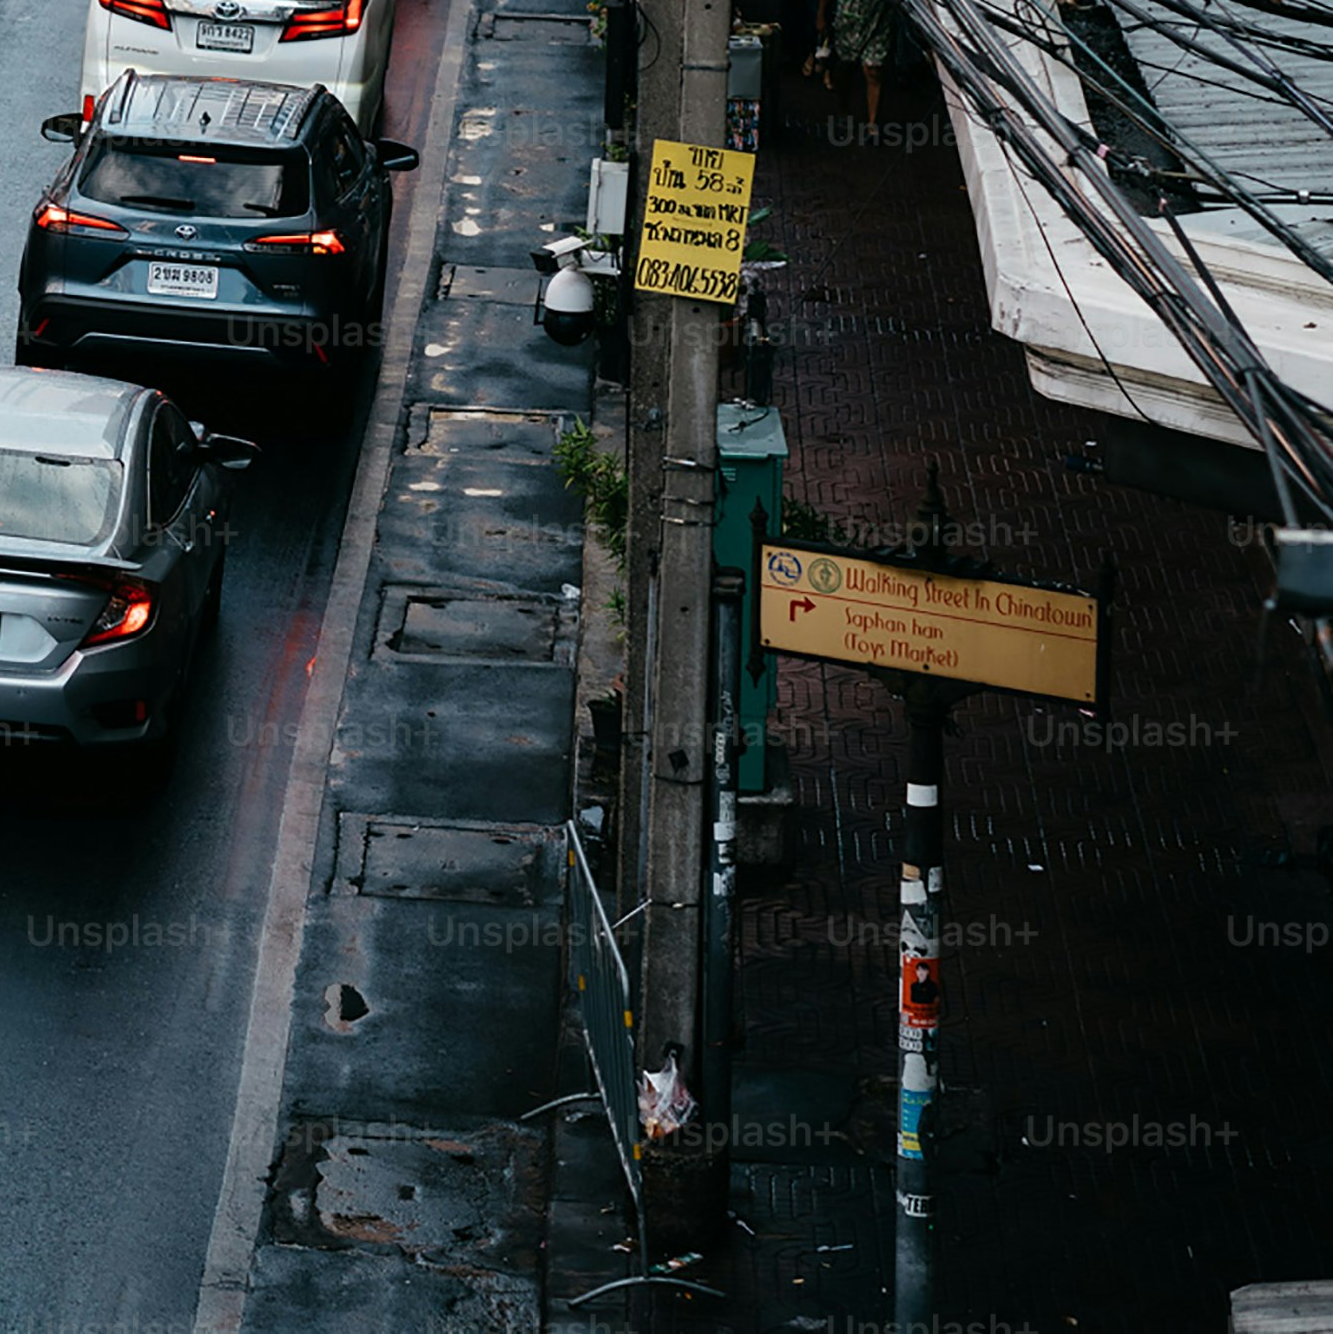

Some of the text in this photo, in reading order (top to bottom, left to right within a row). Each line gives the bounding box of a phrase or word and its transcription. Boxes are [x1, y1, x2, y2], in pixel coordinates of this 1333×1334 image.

[845, 567, 1094, 630] Walking Street In Chinatown
[845, 607, 907, 634] Saphan
[889, 638, 960, 668] Market)
